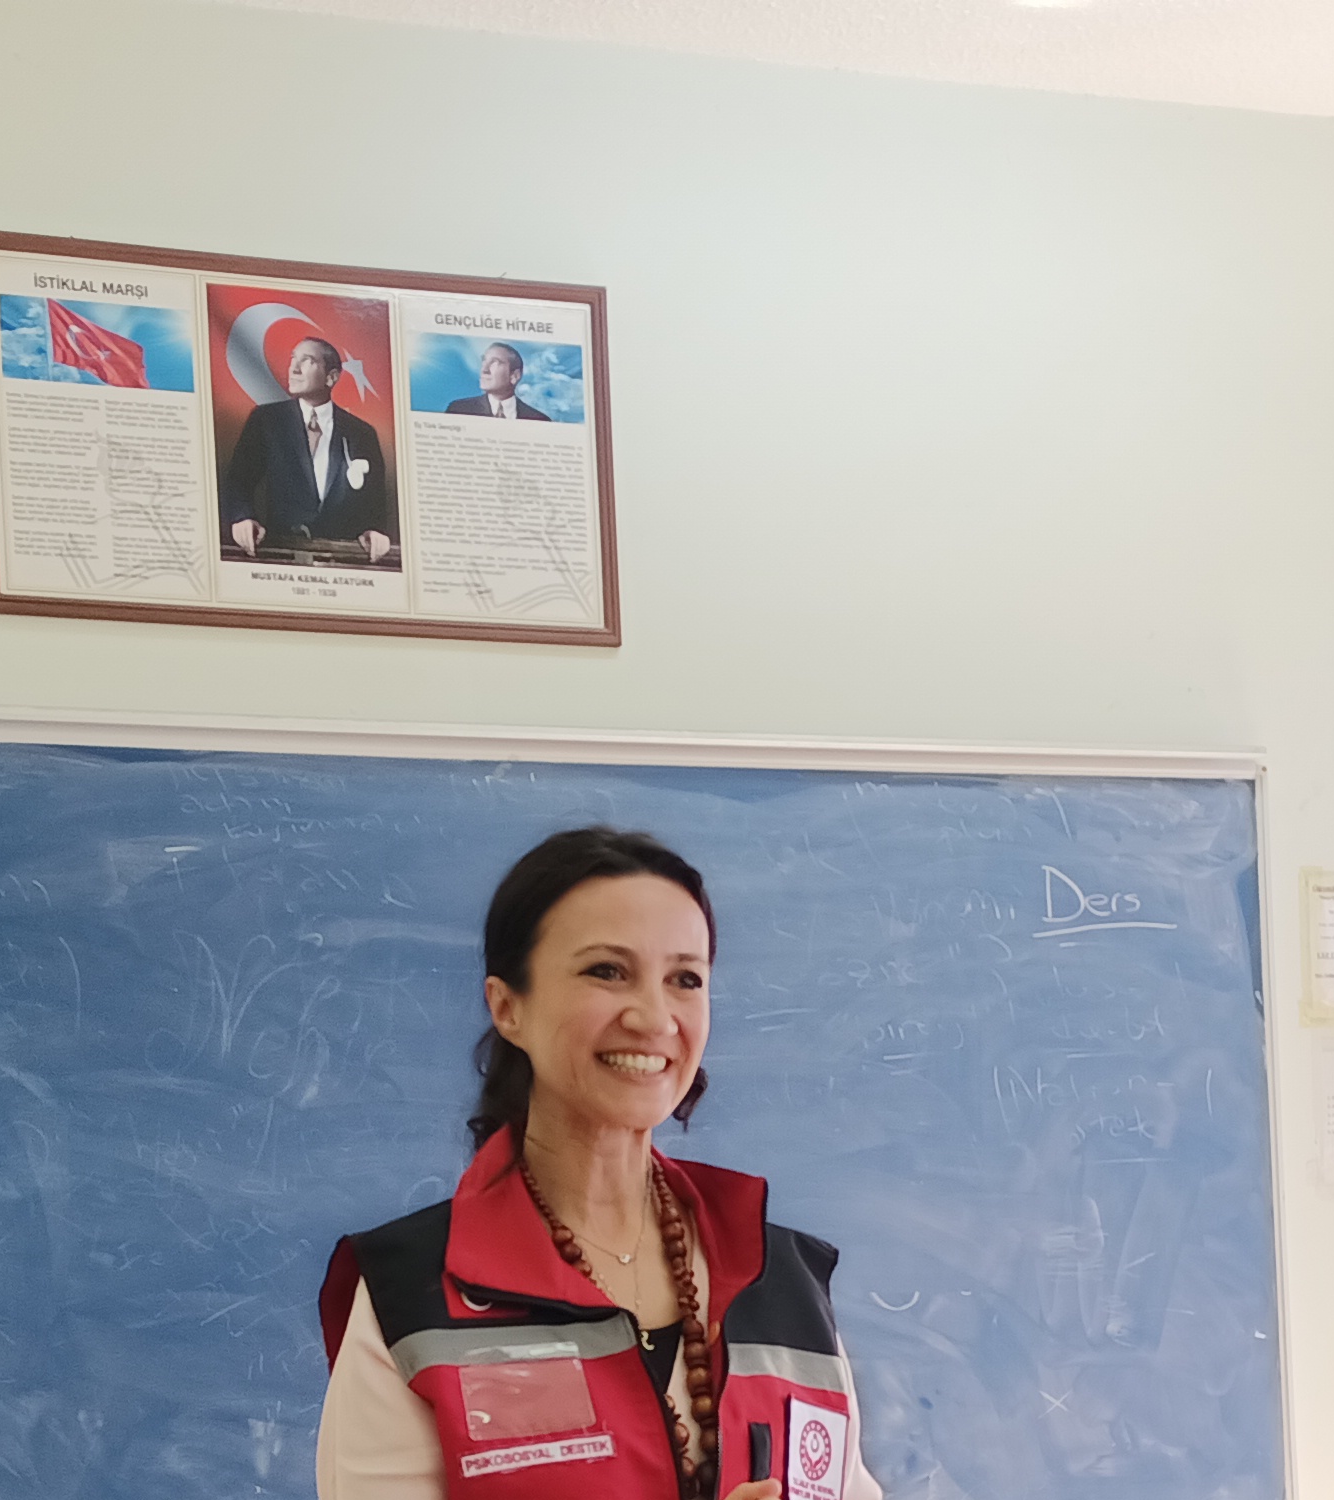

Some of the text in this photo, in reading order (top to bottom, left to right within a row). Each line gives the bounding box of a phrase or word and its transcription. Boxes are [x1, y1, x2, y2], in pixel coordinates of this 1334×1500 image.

[33, 272, 148, 300] İSTİKLAL MARŞI
[434, 313, 554, 334] GENÇLİĞE HİTABE
[1041, 864, 1141, 923] Ders
